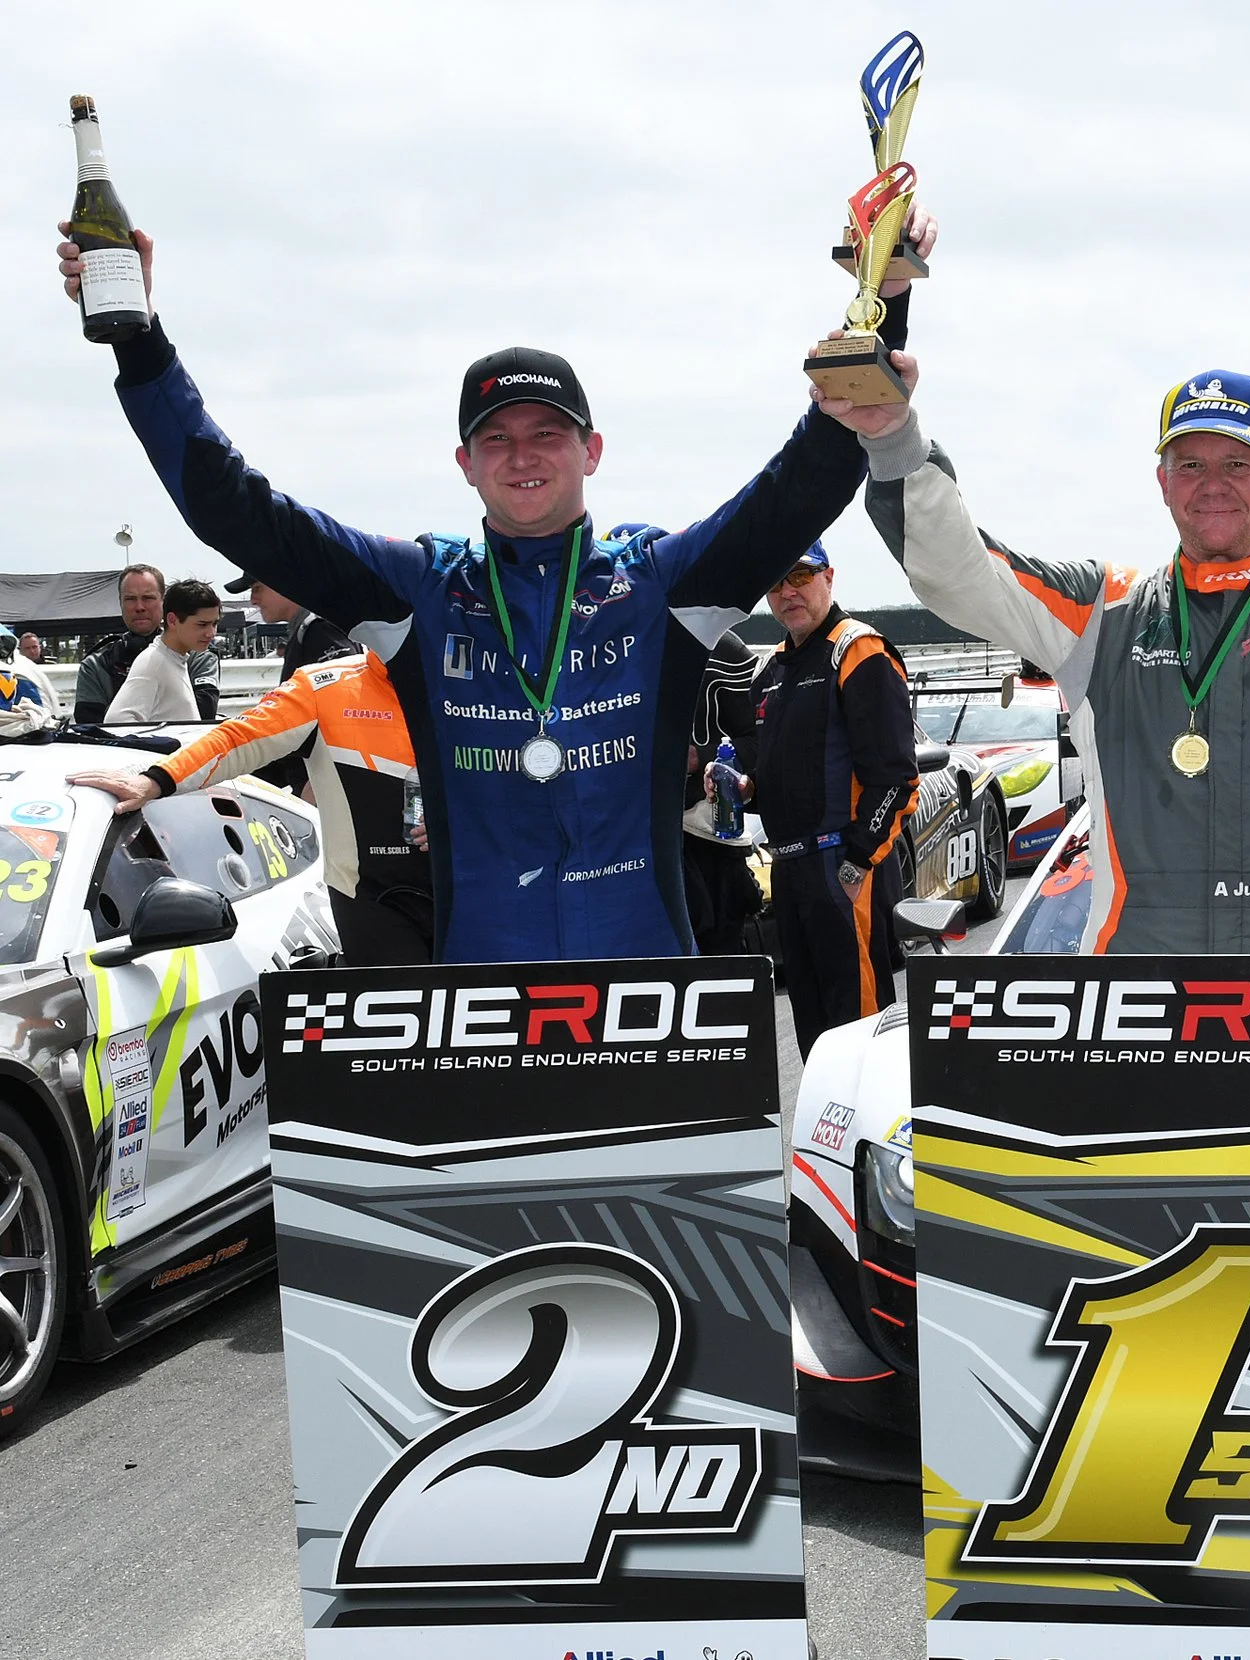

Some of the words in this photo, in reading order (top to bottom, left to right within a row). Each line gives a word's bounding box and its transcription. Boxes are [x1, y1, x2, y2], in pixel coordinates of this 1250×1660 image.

[498, 374, 561, 389] YOKOHAMA
[1173, 401, 1250, 420] MICHELIN
[558, 635, 635, 674] RISP
[344, 709, 393, 721] CLAAS
[444, 700, 534, 722] Southland
[561, 692, 641, 721] Batteries
[562, 868, 602, 882] JORDAN
[602, 858, 646, 877] MICHELS
[946, 829, 978, 885] 88
[1214, 882, 1229, 896] A
[321, 978, 755, 1052] SIERDC
[117, 1038, 144, 1055] brembo
[997, 1049, 1075, 1063] SOUTH
[1083, 1050, 1165, 1063] ISLAND
[180, 989, 264, 1148] EVO
[351, 1057, 425, 1073] SOUTH
[434, 1054, 512, 1070] ISLAND
[521, 1049, 657, 1068] ENDURANCE
[666, 1047, 747, 1063] SERIES
[119, 1095, 147, 1122] Allied
[822, 1102, 854, 1128] LIQUI
[813, 1122, 846, 1149] MOLY
